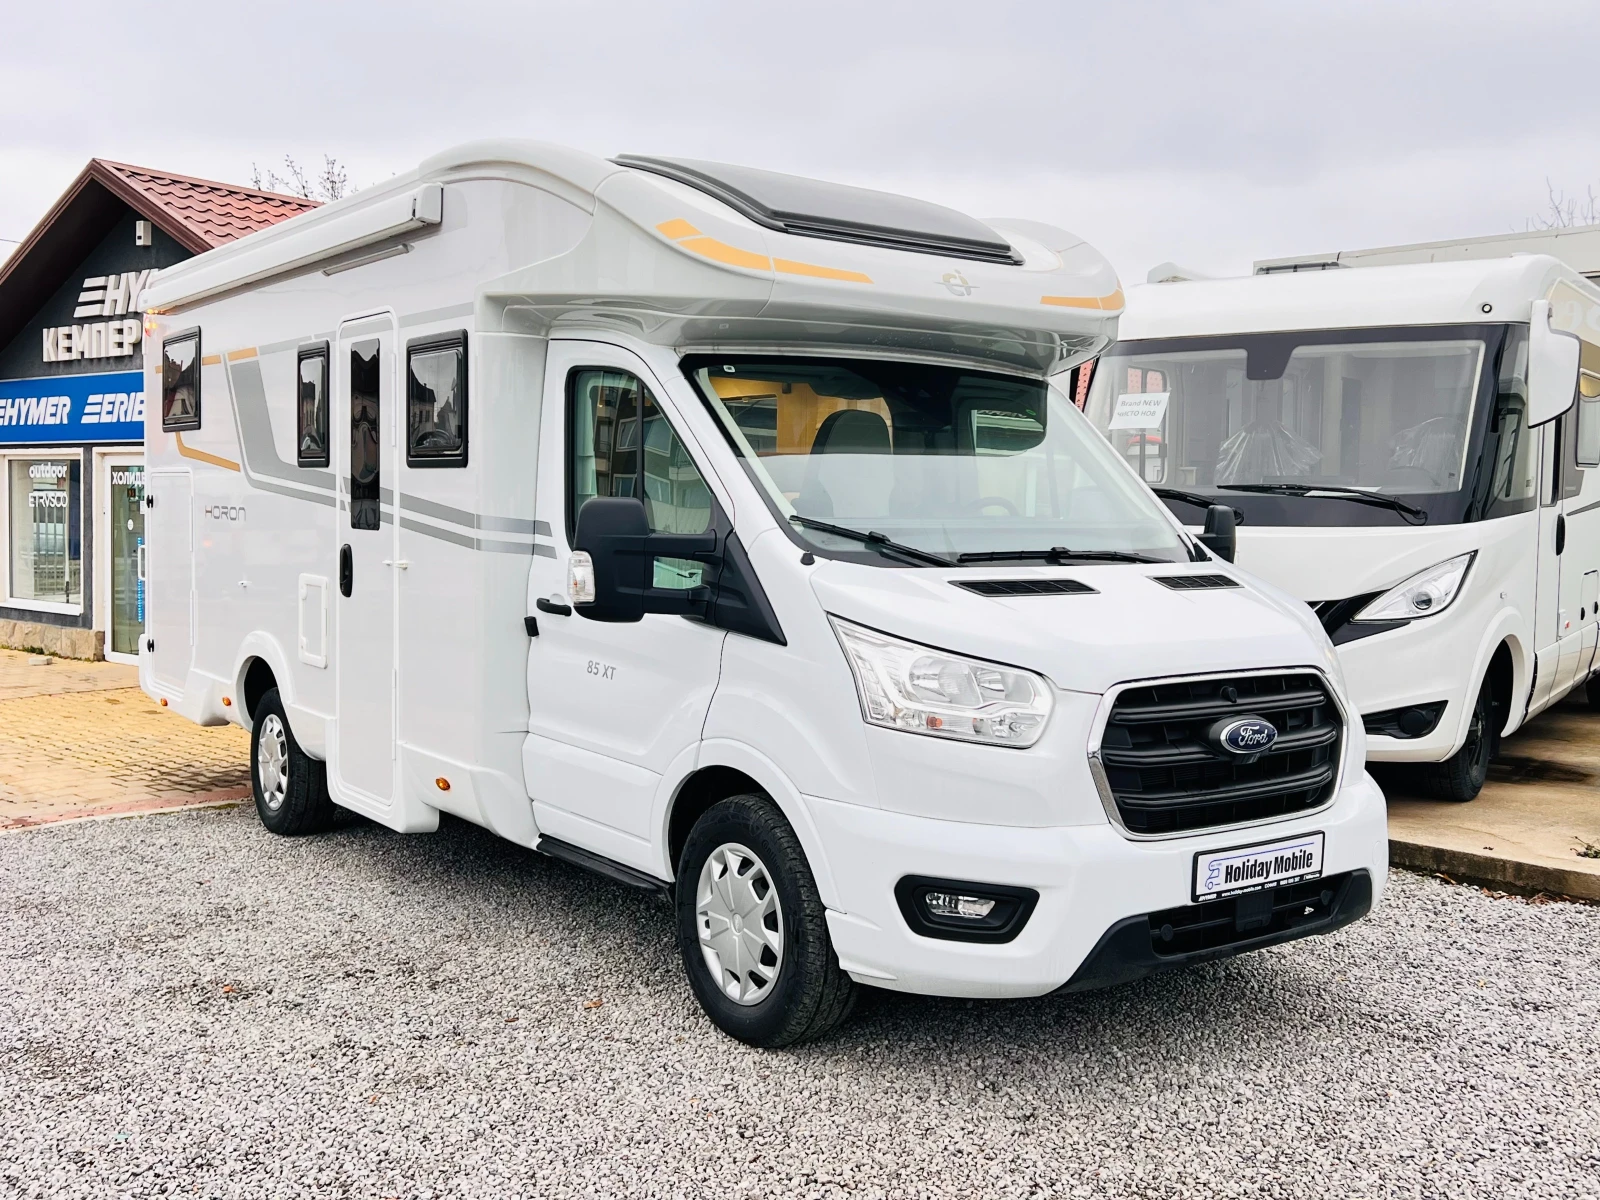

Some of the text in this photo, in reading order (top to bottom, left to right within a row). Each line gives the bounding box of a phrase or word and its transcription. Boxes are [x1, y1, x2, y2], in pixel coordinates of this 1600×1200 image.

[42, 319, 142, 362] КЕМПЕР
[1142, 399, 1162, 407] NEW
[29, 461, 68, 478] outdoor
[586, 660, 617, 680] 85 XT
[1238, 725, 1269, 746] Ford
[1224, 849, 1313, 884] Holiday Mobile
